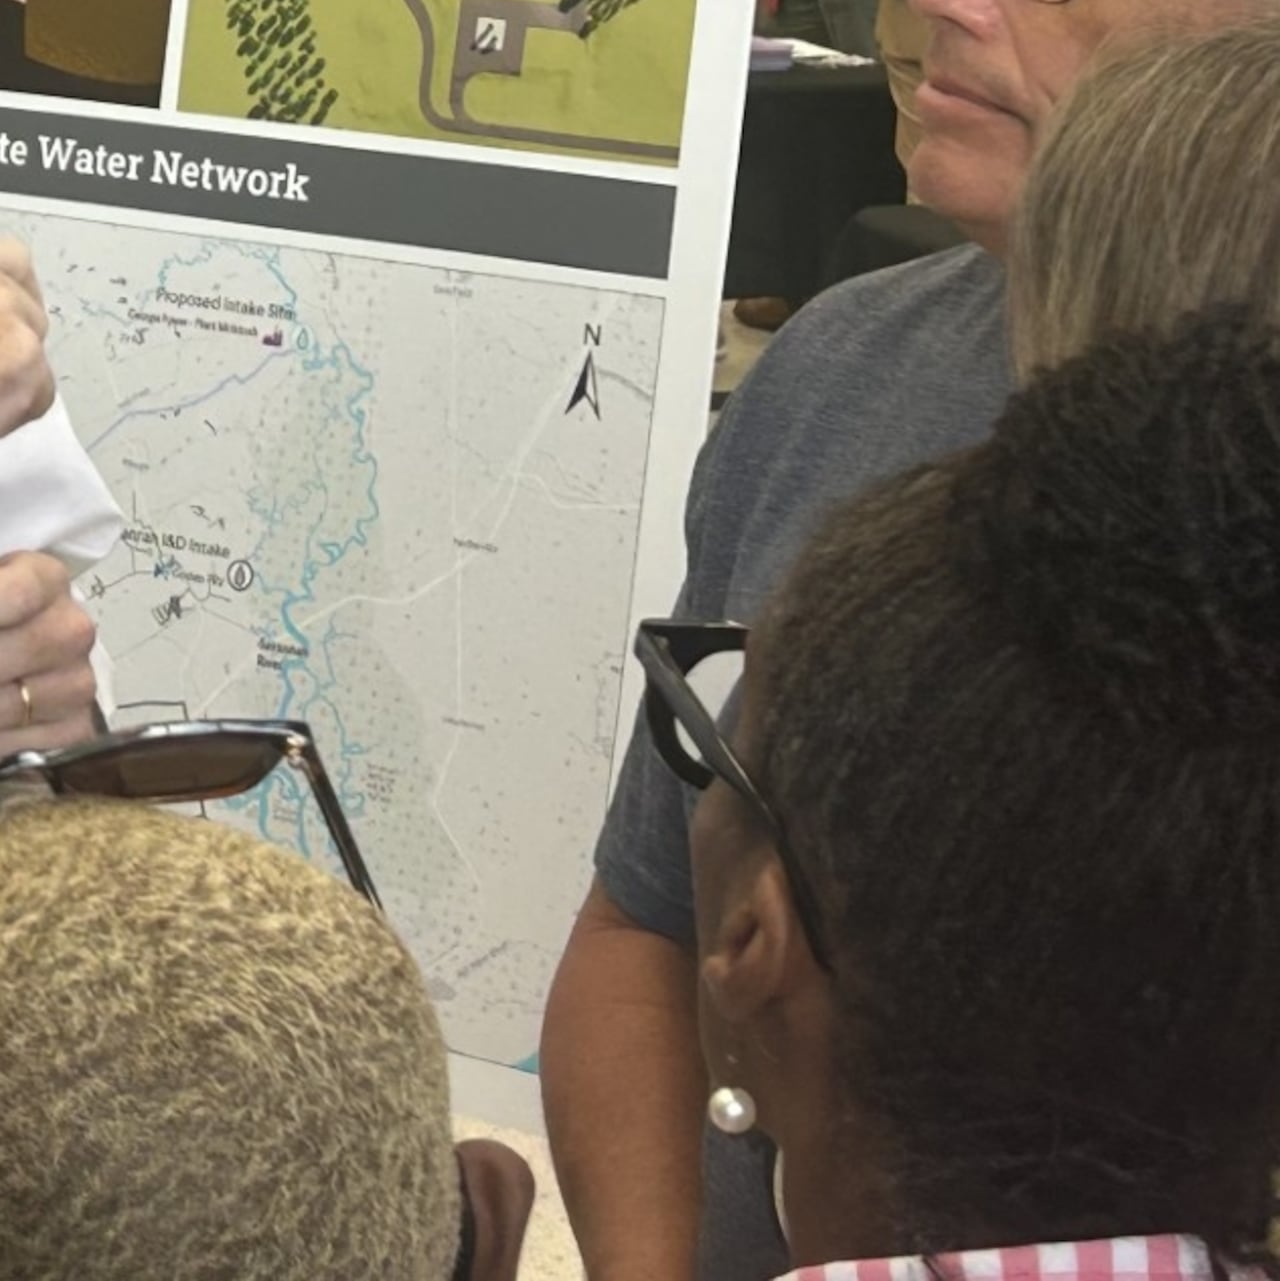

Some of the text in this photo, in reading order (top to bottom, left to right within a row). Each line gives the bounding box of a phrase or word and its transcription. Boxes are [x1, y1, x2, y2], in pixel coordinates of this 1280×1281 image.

[37, 135, 143, 181] Water
[149, 150, 311, 202] Network
[156, 286, 221, 310] Proposed
[583, 322, 602, 346] N
[190, 538, 231, 558] Intake
